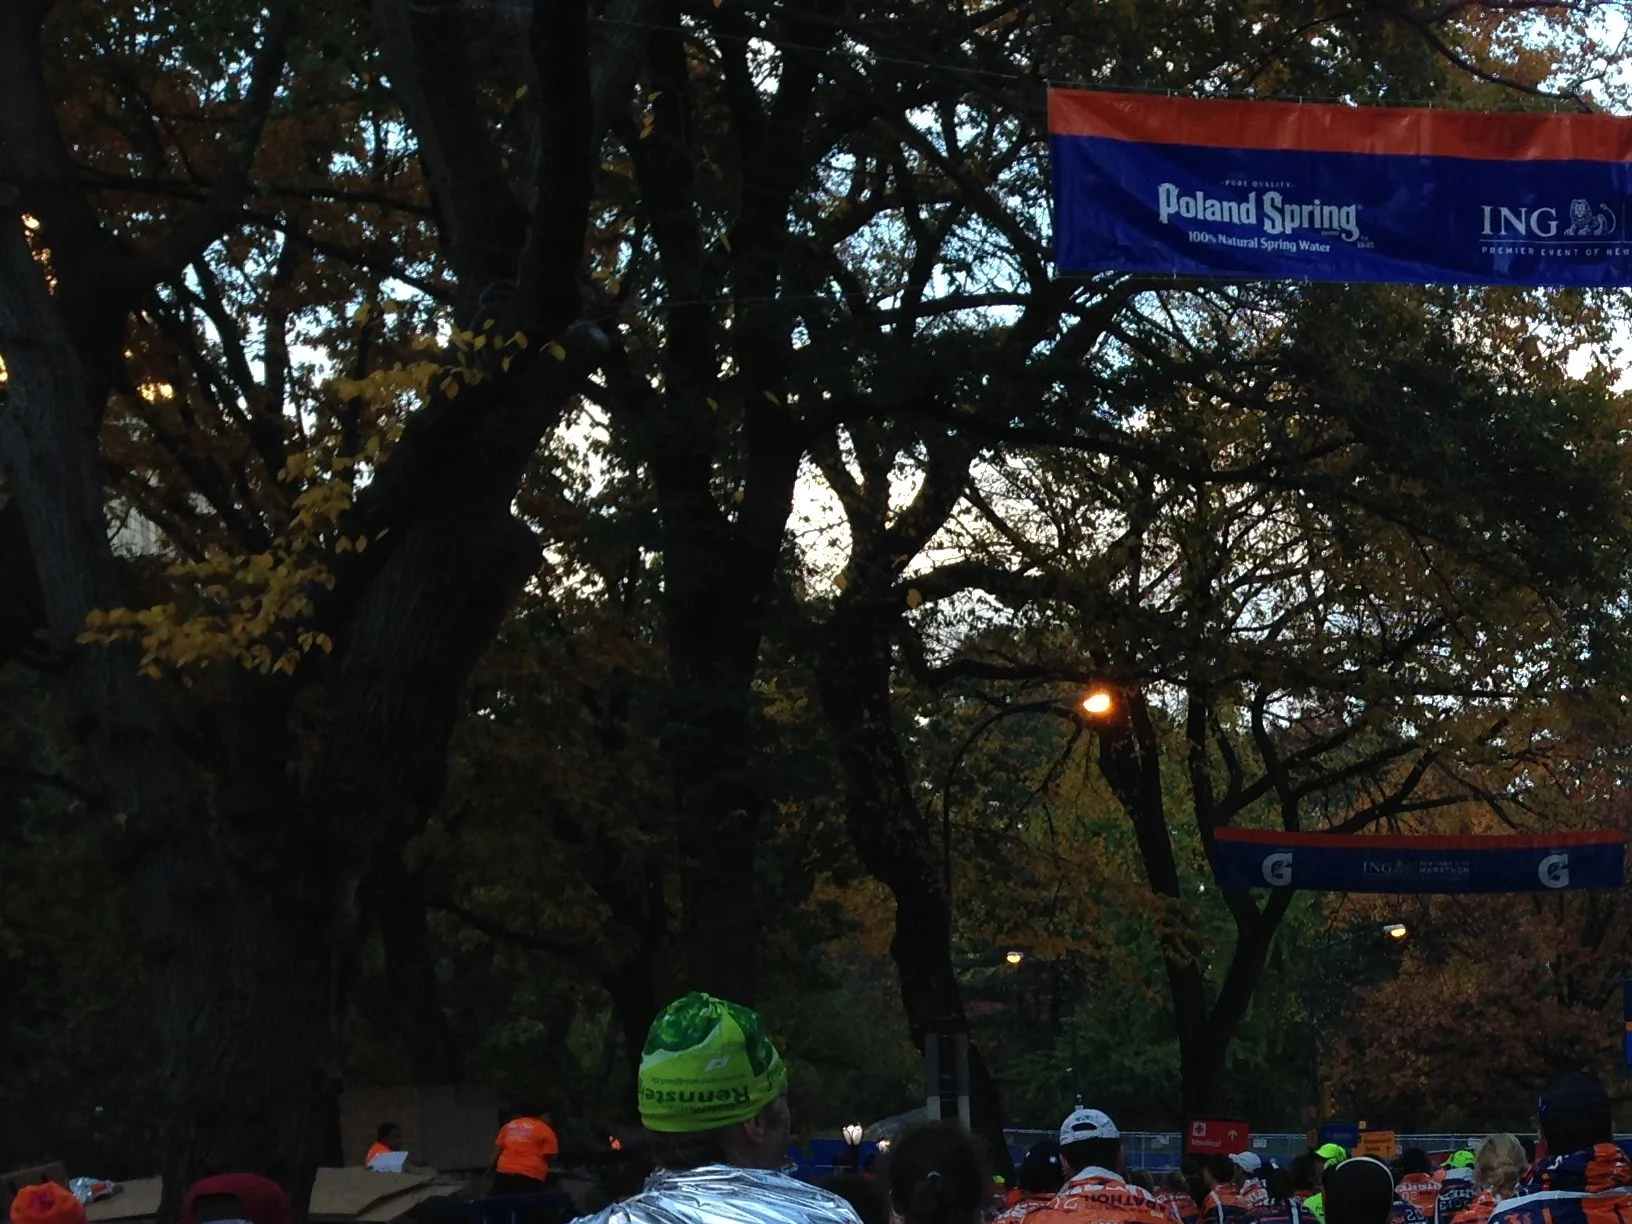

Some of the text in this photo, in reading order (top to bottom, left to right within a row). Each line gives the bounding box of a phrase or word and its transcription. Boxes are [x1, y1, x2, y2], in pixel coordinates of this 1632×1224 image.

[1158, 182, 1361, 242] Poland Spring
[1480, 205, 1559, 237] ING
[1188, 231, 1331, 253] 100% Natural Spring Water
[1482, 246, 1534, 256] PREMIER
[1540, 248, 1579, 257] EVENT
[1606, 247, 1630, 256] NEW
